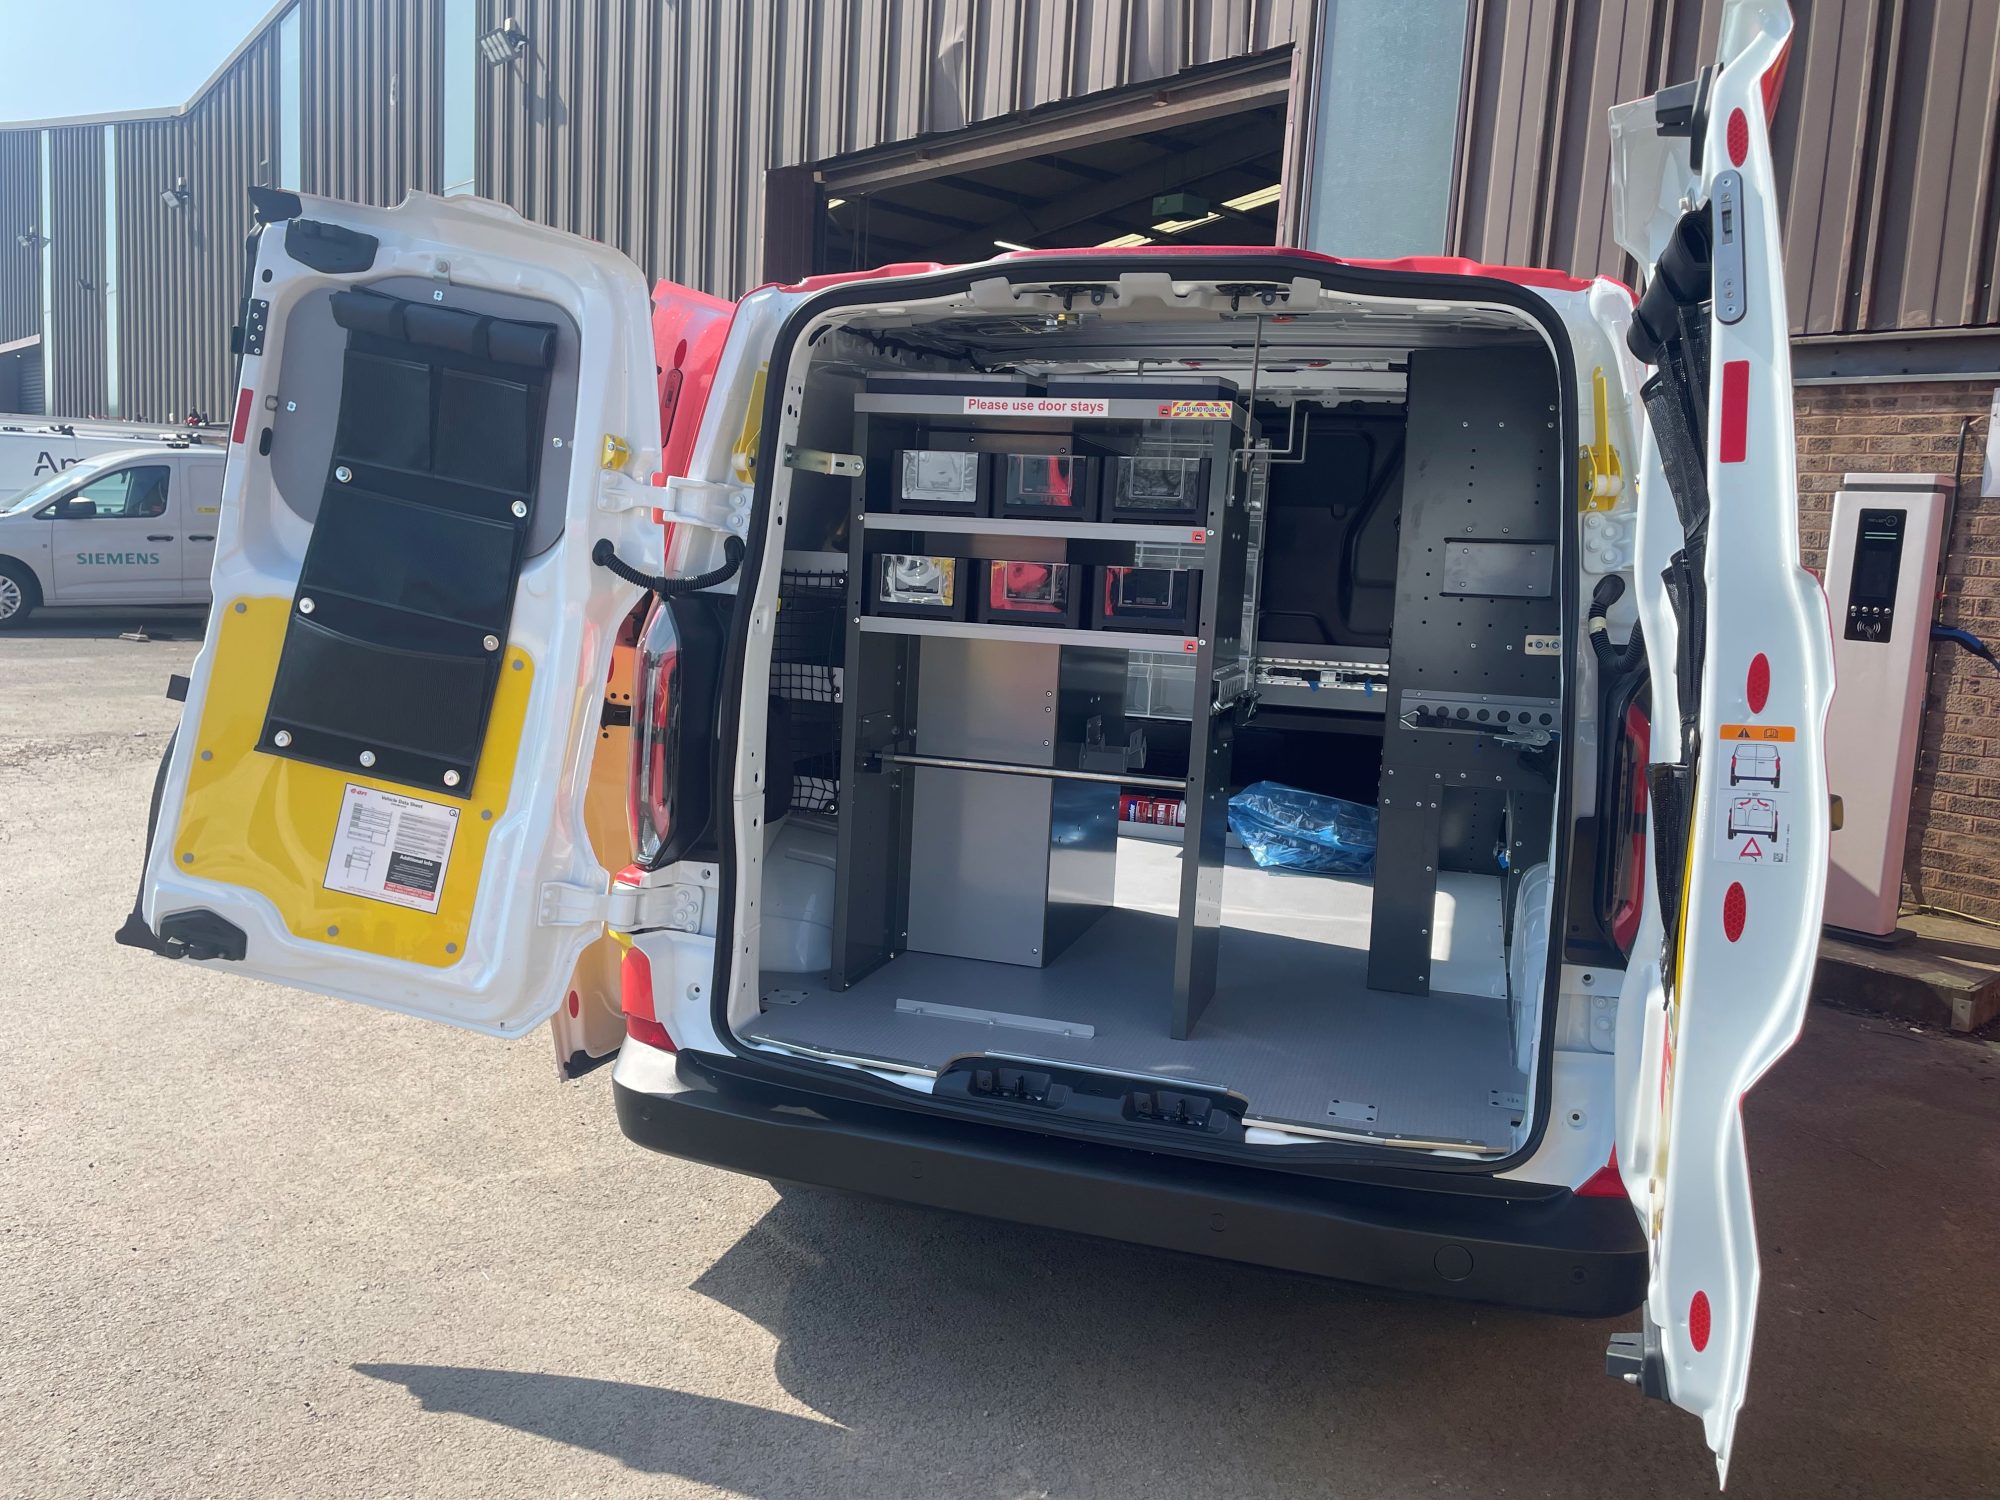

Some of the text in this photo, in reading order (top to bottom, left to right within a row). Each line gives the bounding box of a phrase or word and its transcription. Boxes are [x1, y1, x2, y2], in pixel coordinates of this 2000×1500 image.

[968, 399, 1104, 414] Please use door stays
[76, 552, 160, 565] SIEMENS
[381, 795, 398, 803] Vehicle
[400, 854, 433, 867] Additional Info
